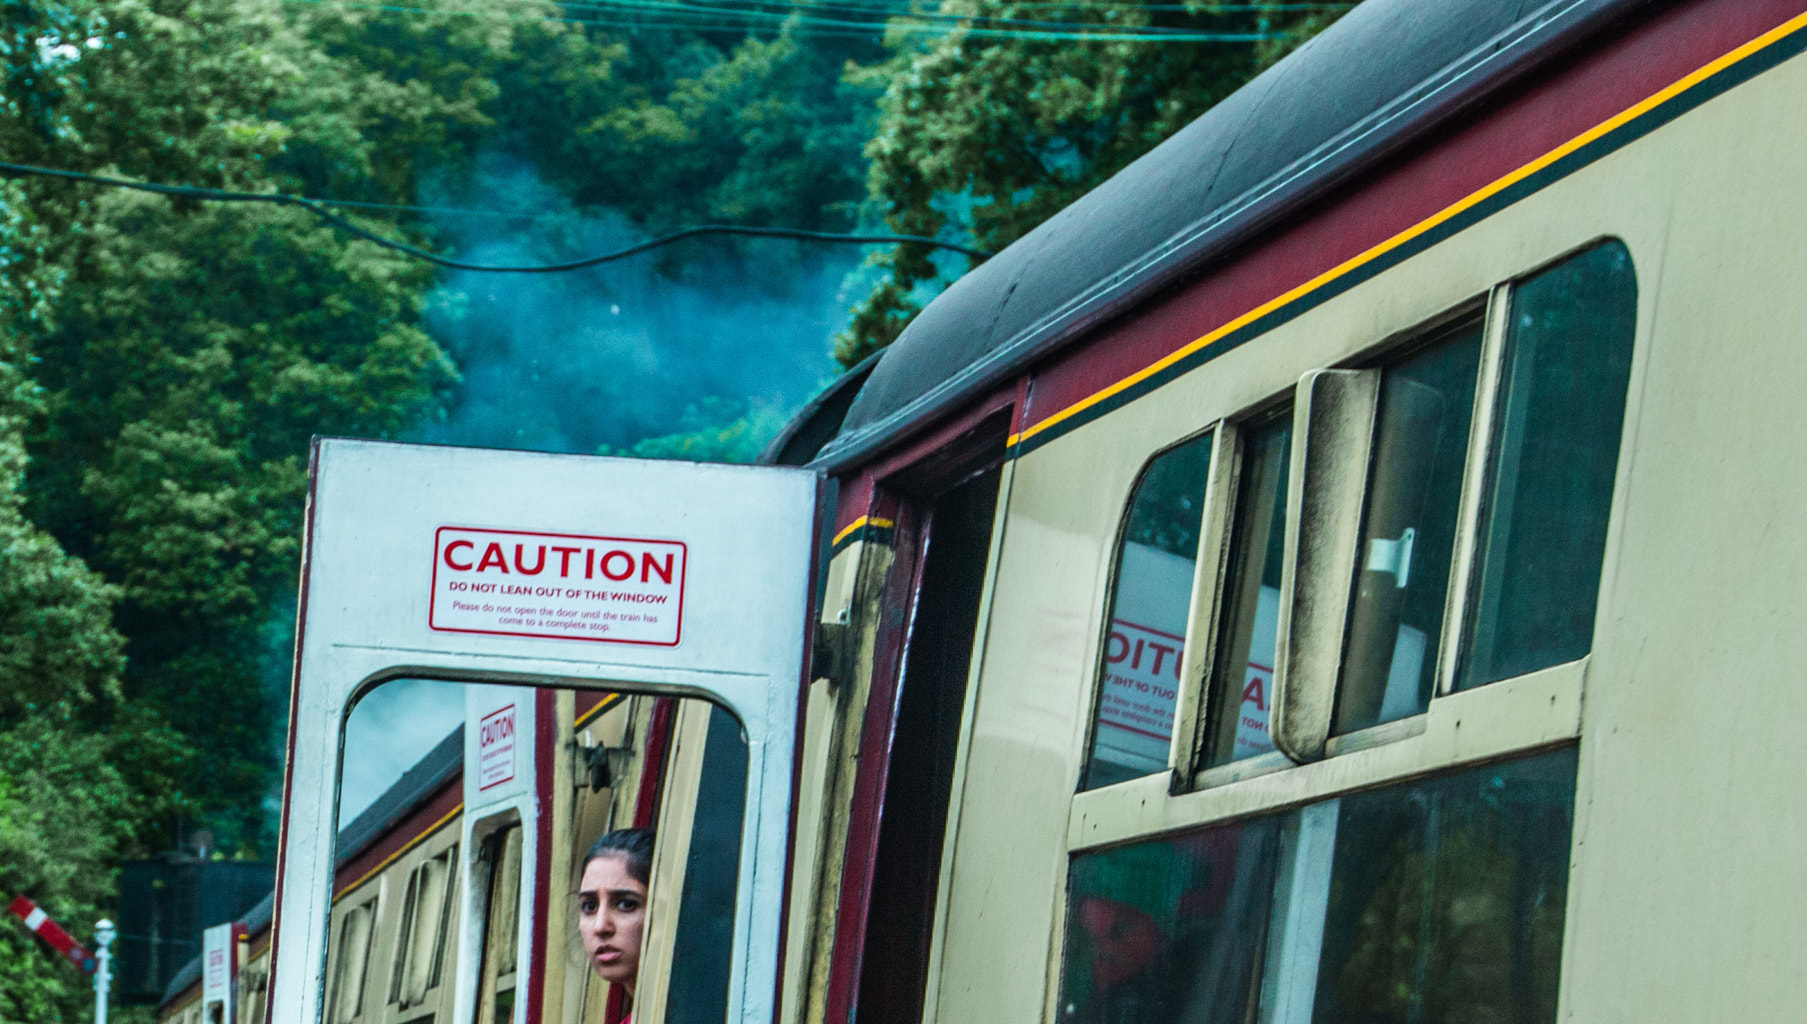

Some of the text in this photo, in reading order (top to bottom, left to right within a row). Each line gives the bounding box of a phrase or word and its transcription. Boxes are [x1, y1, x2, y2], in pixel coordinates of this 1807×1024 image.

[443, 540, 674, 584] CAUTION
[449, 581, 668, 604] DO NOT LEAN OUT OF THE WINDOW
[453, 600, 658, 623] Please do not open the door until the train has
[499, 617, 523, 626] come
[525, 618, 536, 627] to
[538, 620, 544, 628] a
[546, 618, 587, 630] complete
